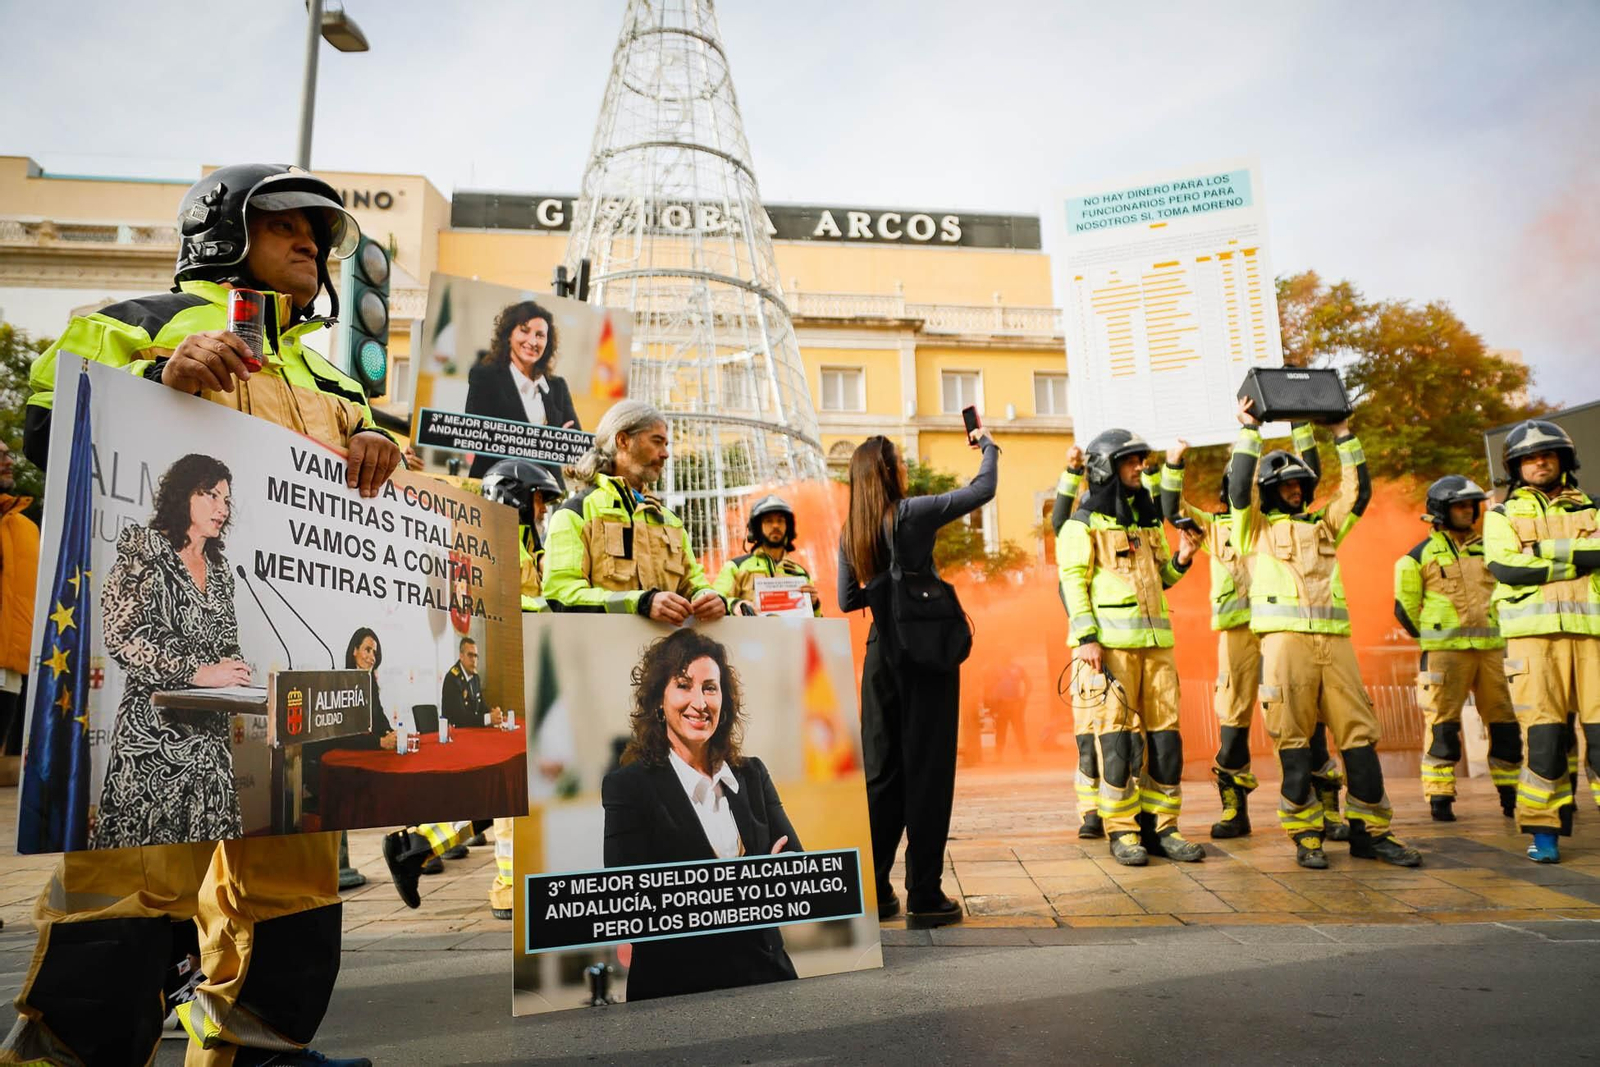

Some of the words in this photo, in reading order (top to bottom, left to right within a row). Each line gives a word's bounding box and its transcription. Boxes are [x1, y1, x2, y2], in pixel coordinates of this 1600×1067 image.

[1082, 199, 1166, 218] FUNCIONARIOS
[1169, 192, 1201, 204] PERO
[1203, 187, 1235, 198] PARA
[1083, 197, 1100, 206] NO
[1102, 193, 1124, 203] HAY
[1127, 185, 1170, 199] DINERO
[1173, 180, 1204, 192] PARA
[1206, 174, 1230, 186] LOS
[813, 210, 963, 242] ARCOS
[1076, 214, 1138, 232] NOSOTROS
[1158, 207, 1190, 218] TOMA
[1192, 198, 1244, 213] MORENO
[428, 424, 492, 441] ANDALUCÍA,
[494, 434, 537, 448] PORQUE
[539, 439, 553, 450] YO
[555, 441, 569, 452] LO
[444, 415, 481, 428] MEJOR
[483, 420, 524, 434] SUELDO
[527, 427, 540, 437] DE
[453, 439, 482, 450] PERO
[485, 442, 505, 453] LOS
[508, 447, 565, 462] BOMBEROS
[290, 446, 349, 485] VAM
[382, 479, 398, 502] A
[403, 485, 482, 528] CONTAR
[267, 476, 395, 533] MENTIRAS
[400, 515, 496, 565] TRALARA,
[288, 519, 377, 565] VAMOS
[382, 544, 398, 567] A
[403, 552, 483, 588] CONTAR
[254, 549, 387, 599] MENTIRAS
[393, 579, 503, 622] TRALARA...
[315, 685, 365, 711] ALMERÍA
[315, 713, 343, 727] CIUDAD
[570, 875, 634, 895] MEJOR
[639, 869, 710, 889] SUELDO
[714, 865, 736, 882] DE
[740, 856, 820, 880] ALCALDÍA
[823, 857, 843, 873] EN
[545, 892, 657, 920] ANDALUCÍA,
[662, 888, 734, 910] PORQUE
[738, 885, 762, 902] YO
[766, 882, 787, 899] LO
[791, 877, 848, 896] VALGO,
[593, 917, 644, 938] PERO
[648, 914, 684, 932] LOS
[688, 904, 784, 928] BOMBEROS
[788, 900, 811, 917] NO
